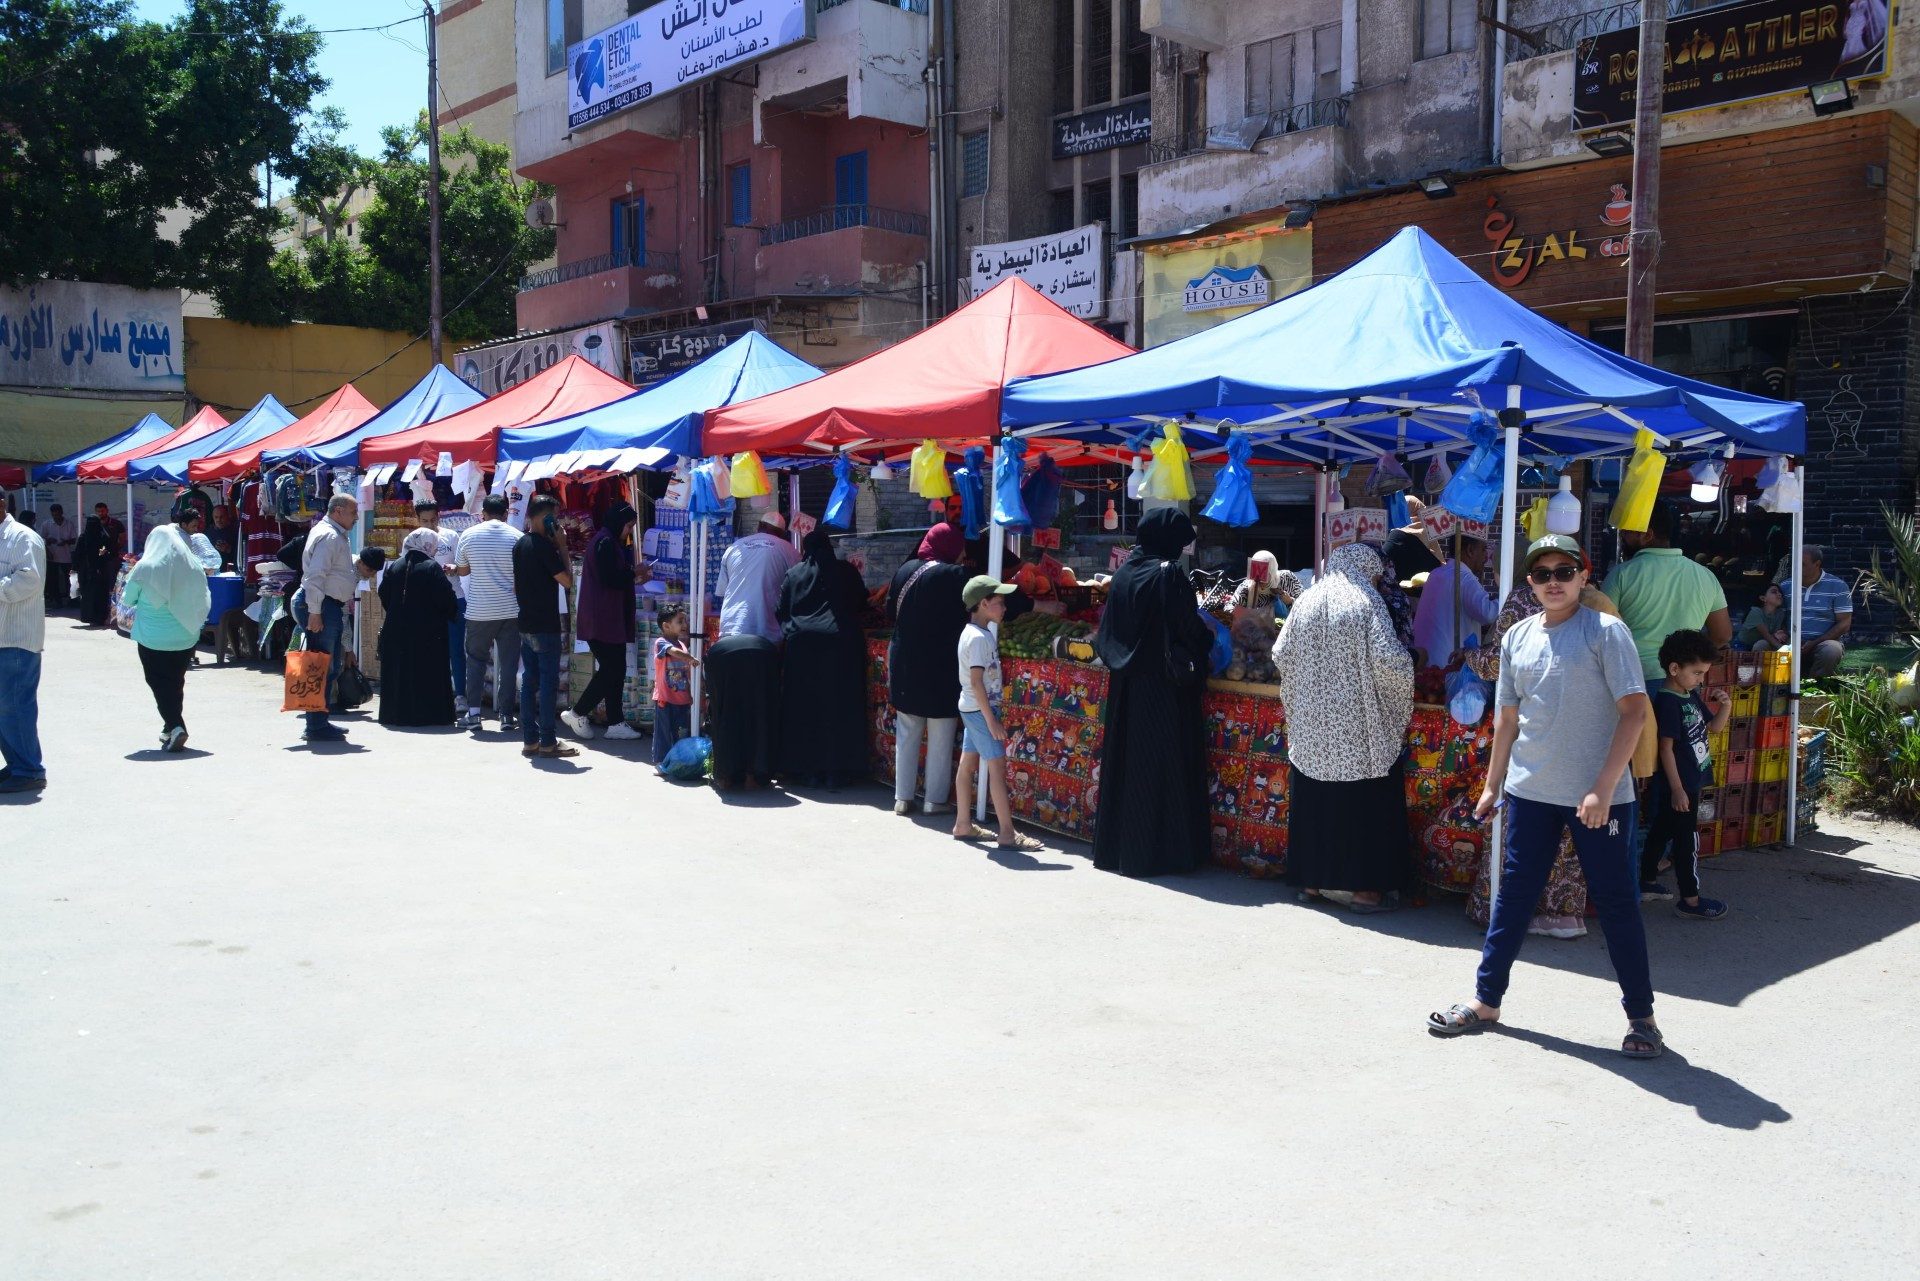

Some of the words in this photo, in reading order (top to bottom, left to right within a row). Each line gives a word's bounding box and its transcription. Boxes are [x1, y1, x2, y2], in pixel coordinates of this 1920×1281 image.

[608, 21, 641, 53] DENTAL
[728, 10, 762, 40] لطب
[608, 44, 631, 71] ETCH
[681, 26, 725, 60] الأسنان
[715, 40, 757, 68] هشام
[1608, 42, 1673, 85] ROA
[1719, 4, 1838, 62] ATTLER
[572, 111, 589, 126] 01556
[589, 106, 599, 118] 444
[1115, 110, 1152, 134] عيادة
[1061, 115, 1115, 150] البيطرية
[1041, 233, 1091, 265] العيادة
[1600, 235, 1630, 256] Caf
[976, 245, 1039, 280] البيطرية
[1185, 282, 1265, 303] HOUSE
[0, 288, 54, 361] الأورم
[61, 306, 122, 366] مدارس
[128, 320, 171, 368] مجمع
[1540, 535, 1558, 547] NY
[1609, 819, 1619, 836] NY
